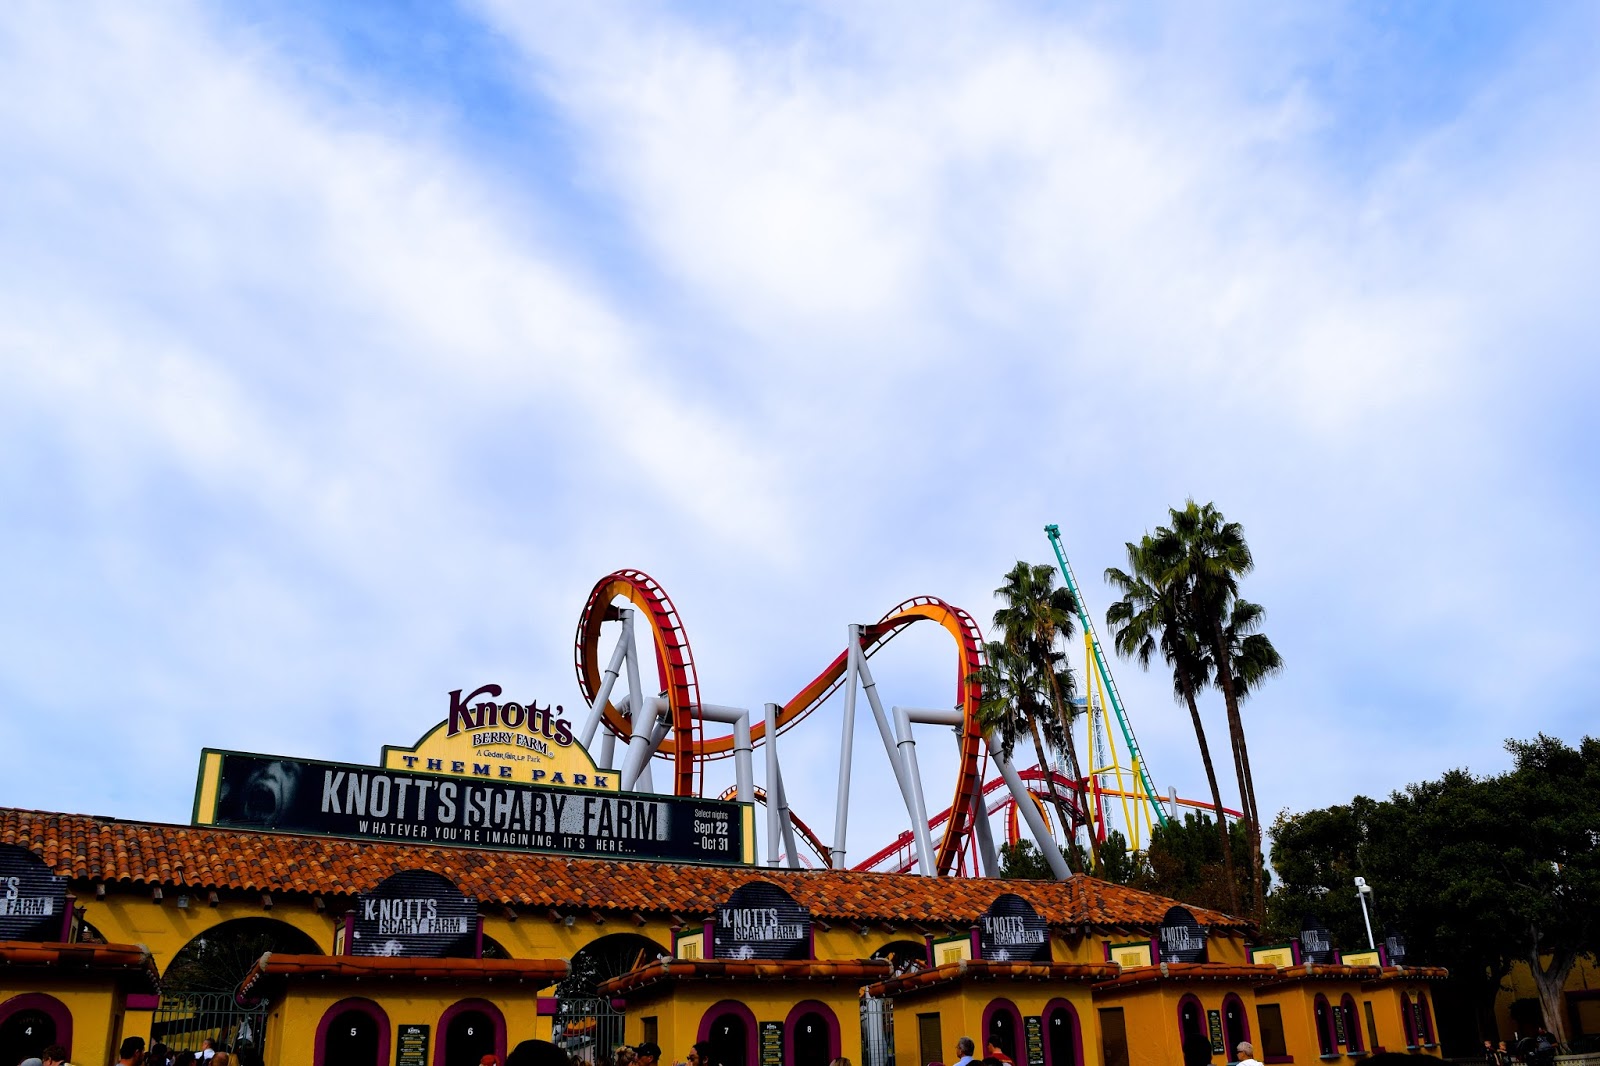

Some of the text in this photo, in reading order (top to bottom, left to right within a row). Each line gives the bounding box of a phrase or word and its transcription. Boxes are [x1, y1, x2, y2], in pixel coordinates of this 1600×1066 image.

[446, 683, 574, 747] Knott's
[472, 731, 548, 756] BERRY FARM
[526, 754, 541, 763] Park
[402, 755, 609, 787] THEME PARK
[321, 769, 659, 842] KNOTT'S SCARY FARM
[694, 808, 729, 820] Select nights
[359, 820, 428, 838] WHATEVER
[435, 826, 480, 842] YOU'RE
[563, 837, 585, 850] IT'S
[694, 819, 728, 835] Sept 22
[701, 836, 716, 850] Oct
[718, 837, 729, 851] 31
[6, 897, 46, 915] FARM
[364, 899, 438, 921] KNOTT'S
[381, 917, 461, 934] SCARY FARM
[24, 1026, 33, 1036] 4
[350, 1027, 357, 1036] 5
[467, 1027, 474, 1036] 6
[724, 1026, 729, 1035] 7
[807, 1025, 812, 1033] 8
